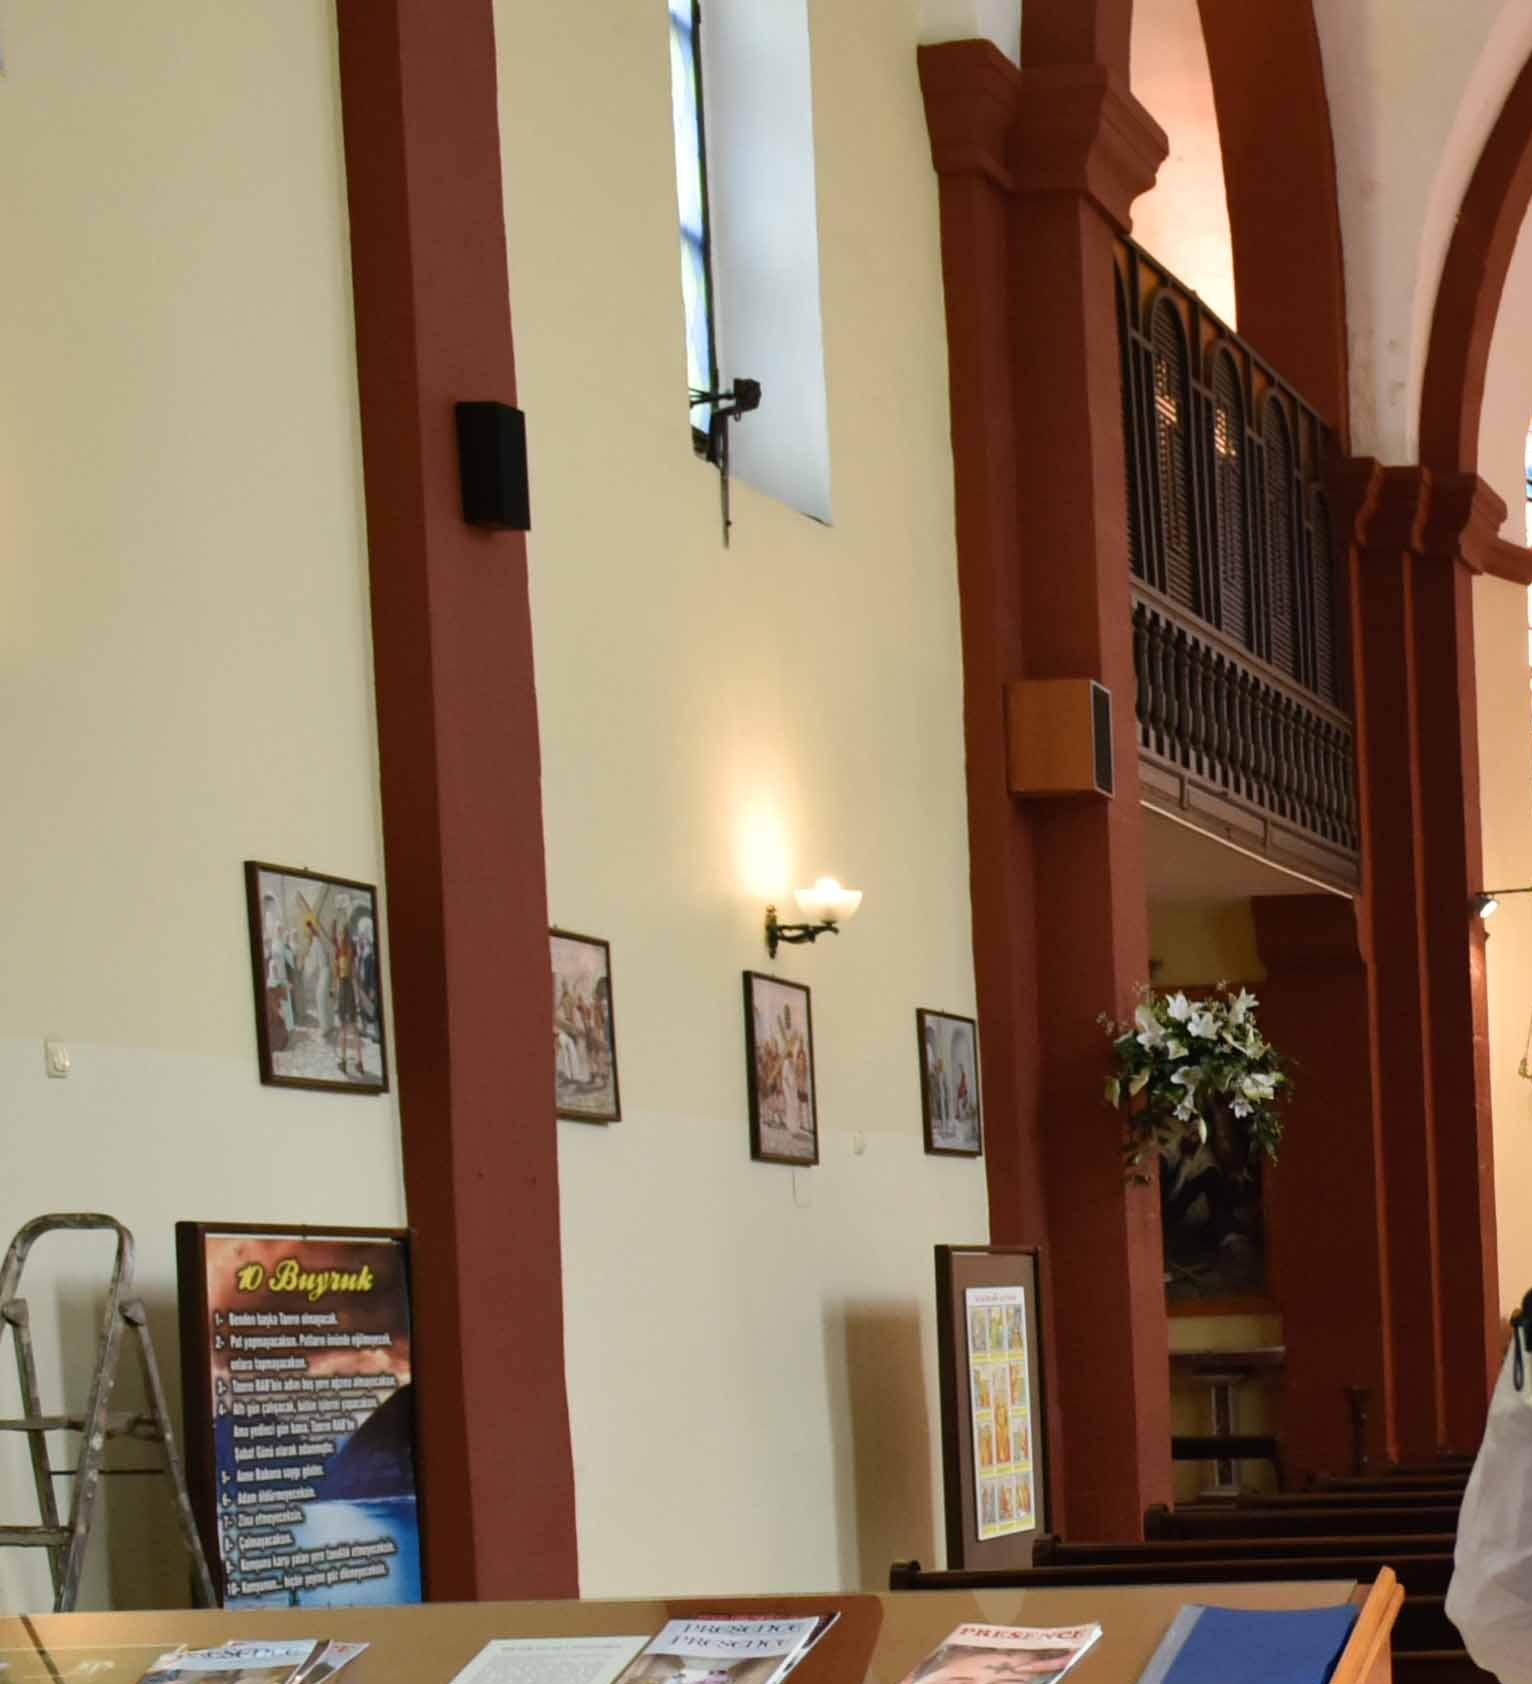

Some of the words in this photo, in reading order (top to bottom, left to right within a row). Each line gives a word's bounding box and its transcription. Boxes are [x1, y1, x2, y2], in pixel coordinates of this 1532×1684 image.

[238, 1264, 263, 1291] 10
[269, 1258, 374, 1302] Buyruk
[959, 1626, 1088, 1641] PRESENCE
